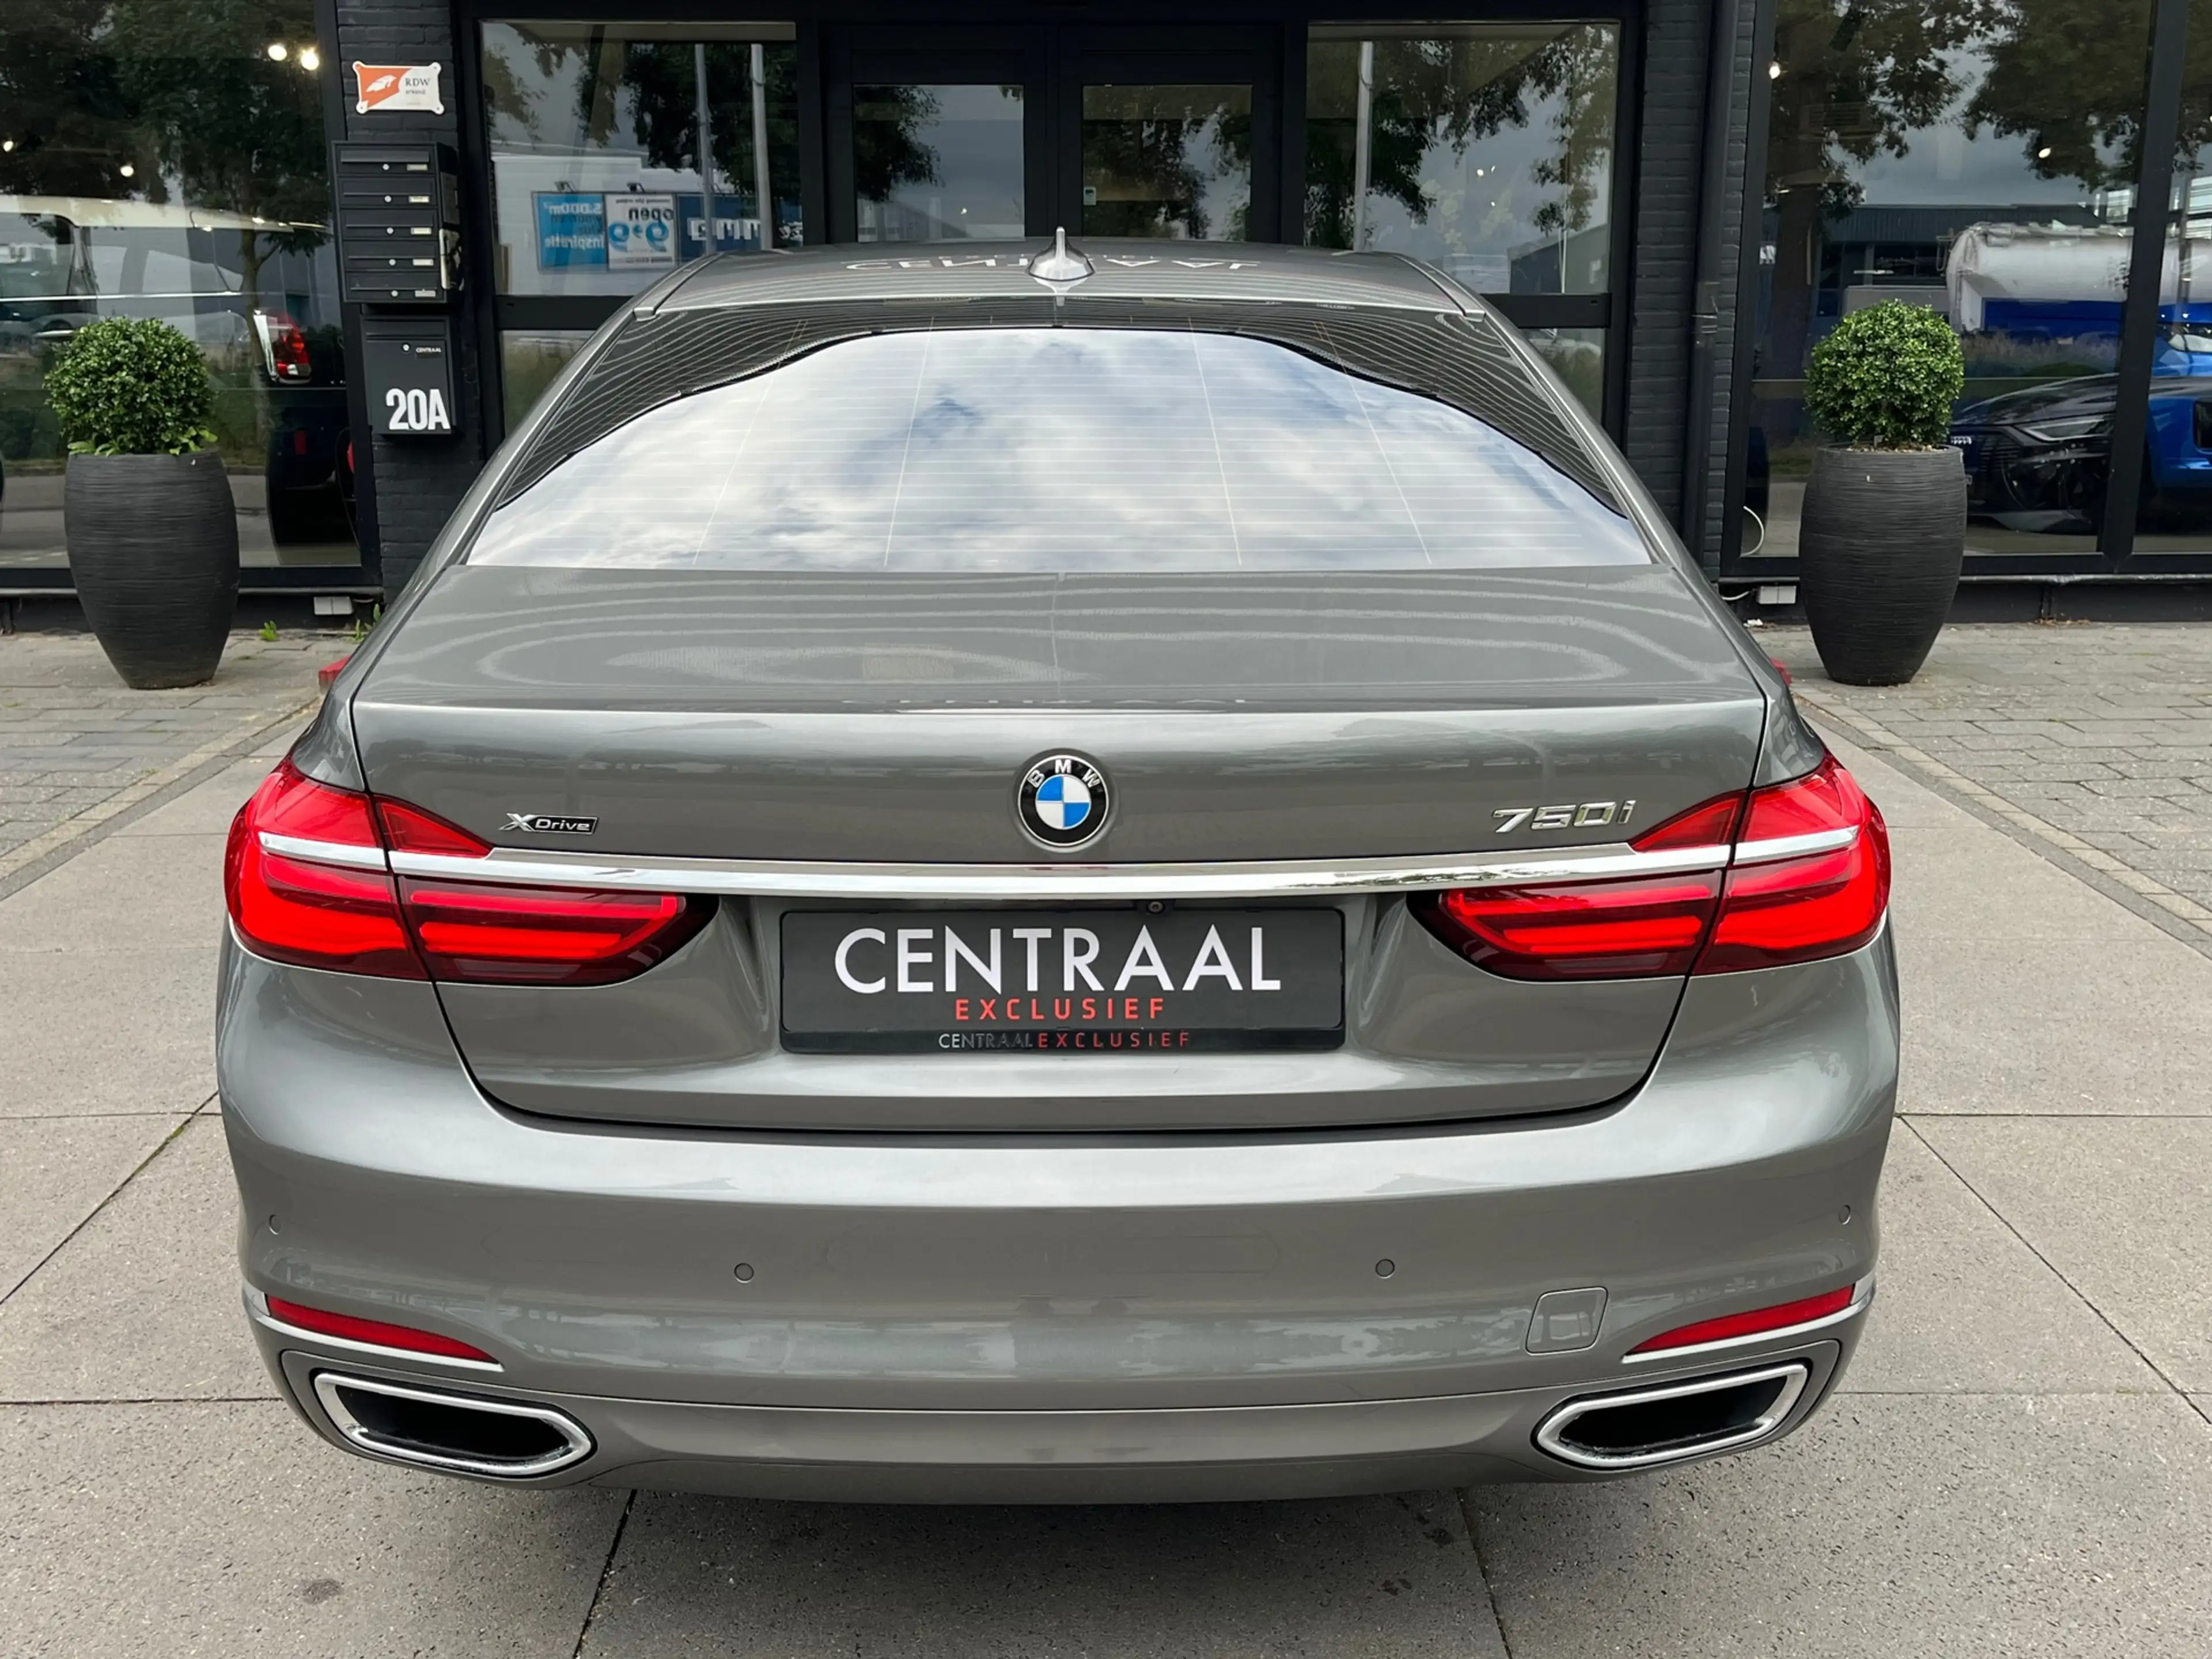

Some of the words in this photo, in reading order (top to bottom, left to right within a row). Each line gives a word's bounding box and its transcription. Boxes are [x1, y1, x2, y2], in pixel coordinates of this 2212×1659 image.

[405, 78, 431, 86] RDW
[386, 388, 450, 431] 20A
[1027, 759, 1101, 788] BMW
[1492, 800, 1636, 832] 750i
[835, 925, 1281, 994] CENTRAAL
[955, 998, 1164, 1020] EXCLUSIEF
